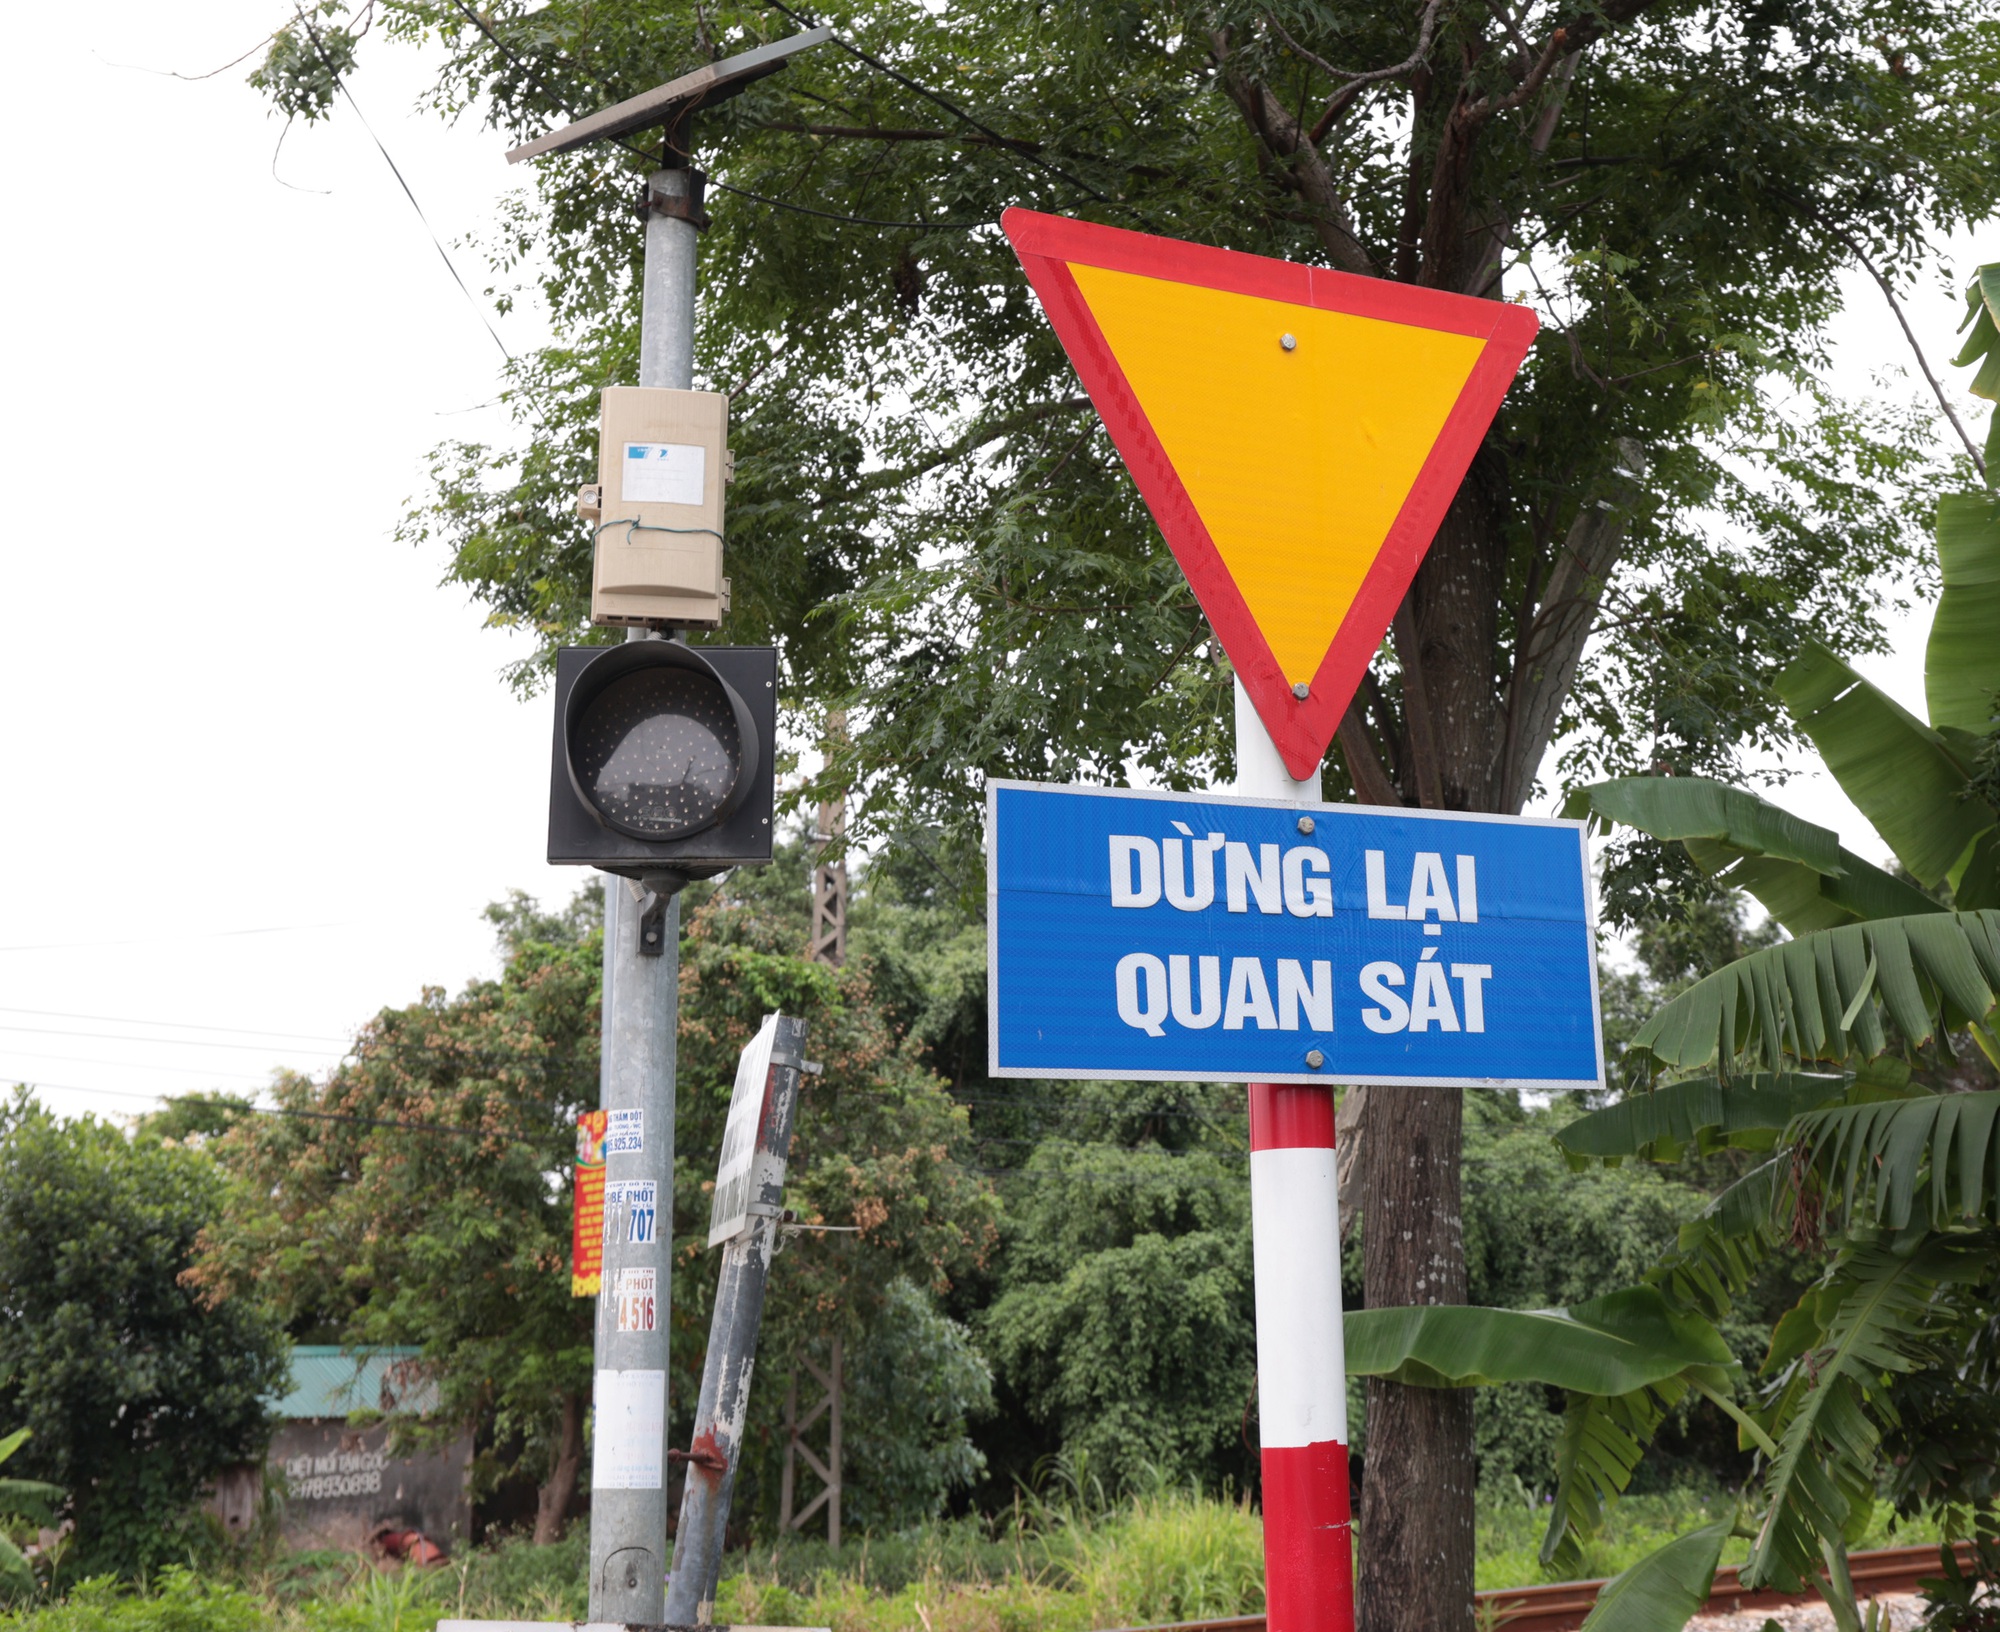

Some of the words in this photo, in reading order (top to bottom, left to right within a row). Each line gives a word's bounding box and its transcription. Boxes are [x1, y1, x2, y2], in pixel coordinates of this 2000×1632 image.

[1109, 820, 1334, 917] DỪNG
[1365, 849, 1479, 936] LẠI
[1115, 952, 1334, 1037] QUAN
[1359, 947, 1492, 1034] SÁT
